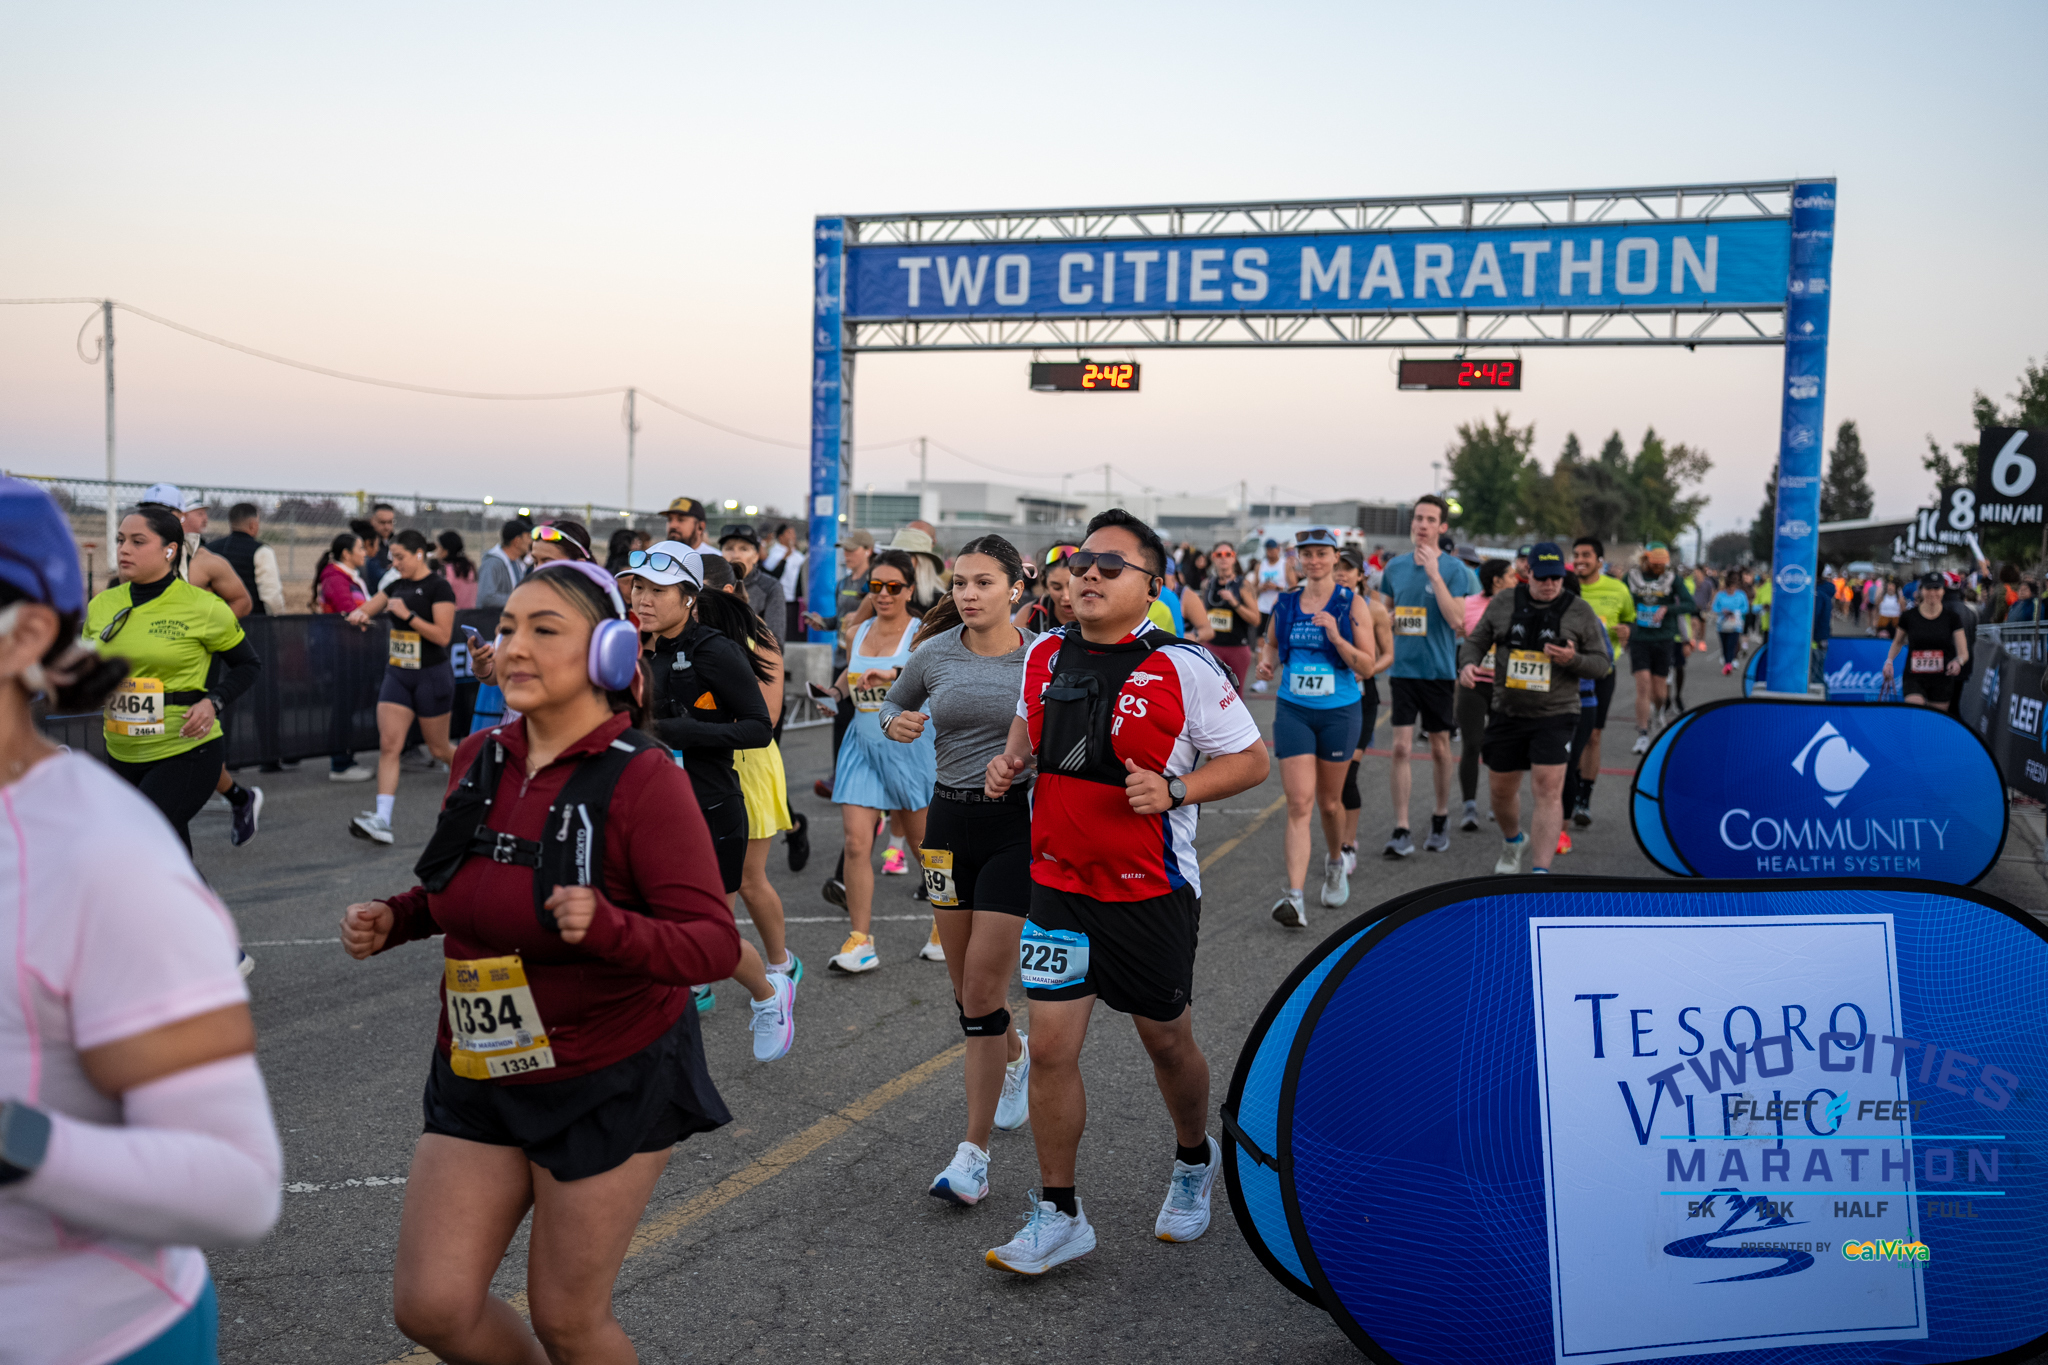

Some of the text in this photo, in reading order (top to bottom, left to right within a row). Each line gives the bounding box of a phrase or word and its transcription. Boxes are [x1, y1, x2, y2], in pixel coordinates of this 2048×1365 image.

[898, 235, 1719, 308] TWO CITIES MARATHON
[1990, 429, 2037, 498] 6
[1948, 487, 1976, 531] 8
[1979, 503, 2043, 526] MIN/MI
[1513, 662, 1544, 676] 1571
[1297, 675, 1323, 689] 747
[109, 695, 155, 714] 2464
[1719, 808, 1950, 851] COMMUNITY
[1757, 856, 1921, 872] HEALTH SYSTEM
[1021, 943, 1068, 975] 225
[1032, 976, 1063, 984] MARATHON
[452, 994, 523, 1034] 1334
[478, 1039, 513, 1050] MARATHON
[501, 1055, 539, 1074] 1334
